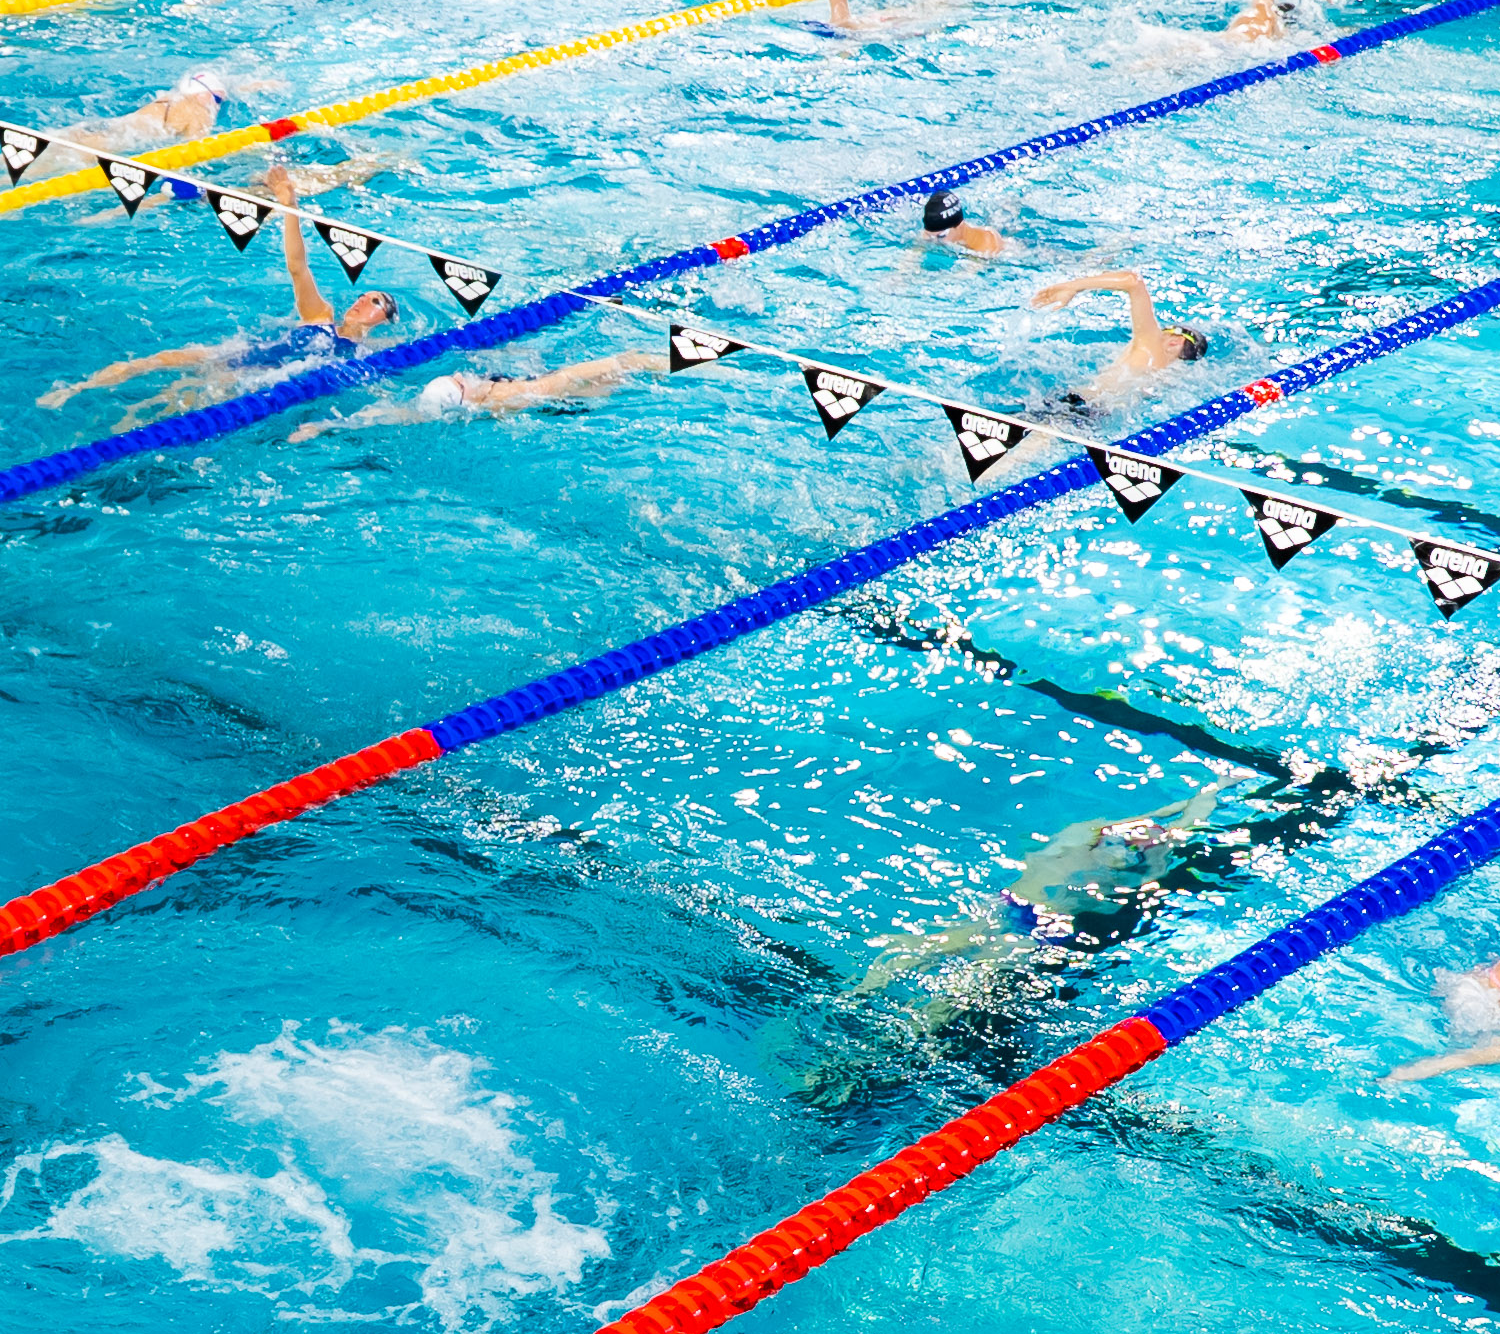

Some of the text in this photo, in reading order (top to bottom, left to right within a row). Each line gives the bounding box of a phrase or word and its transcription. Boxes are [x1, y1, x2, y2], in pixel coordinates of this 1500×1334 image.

[329, 226, 368, 251] arena
[444, 260, 488, 284] arena
[816, 370, 866, 400] arena
[961, 411, 1011, 442] arena
[1109, 455, 1162, 484] arena
[1262, 497, 1318, 530] arena
[1429, 546, 1490, 580] arena
